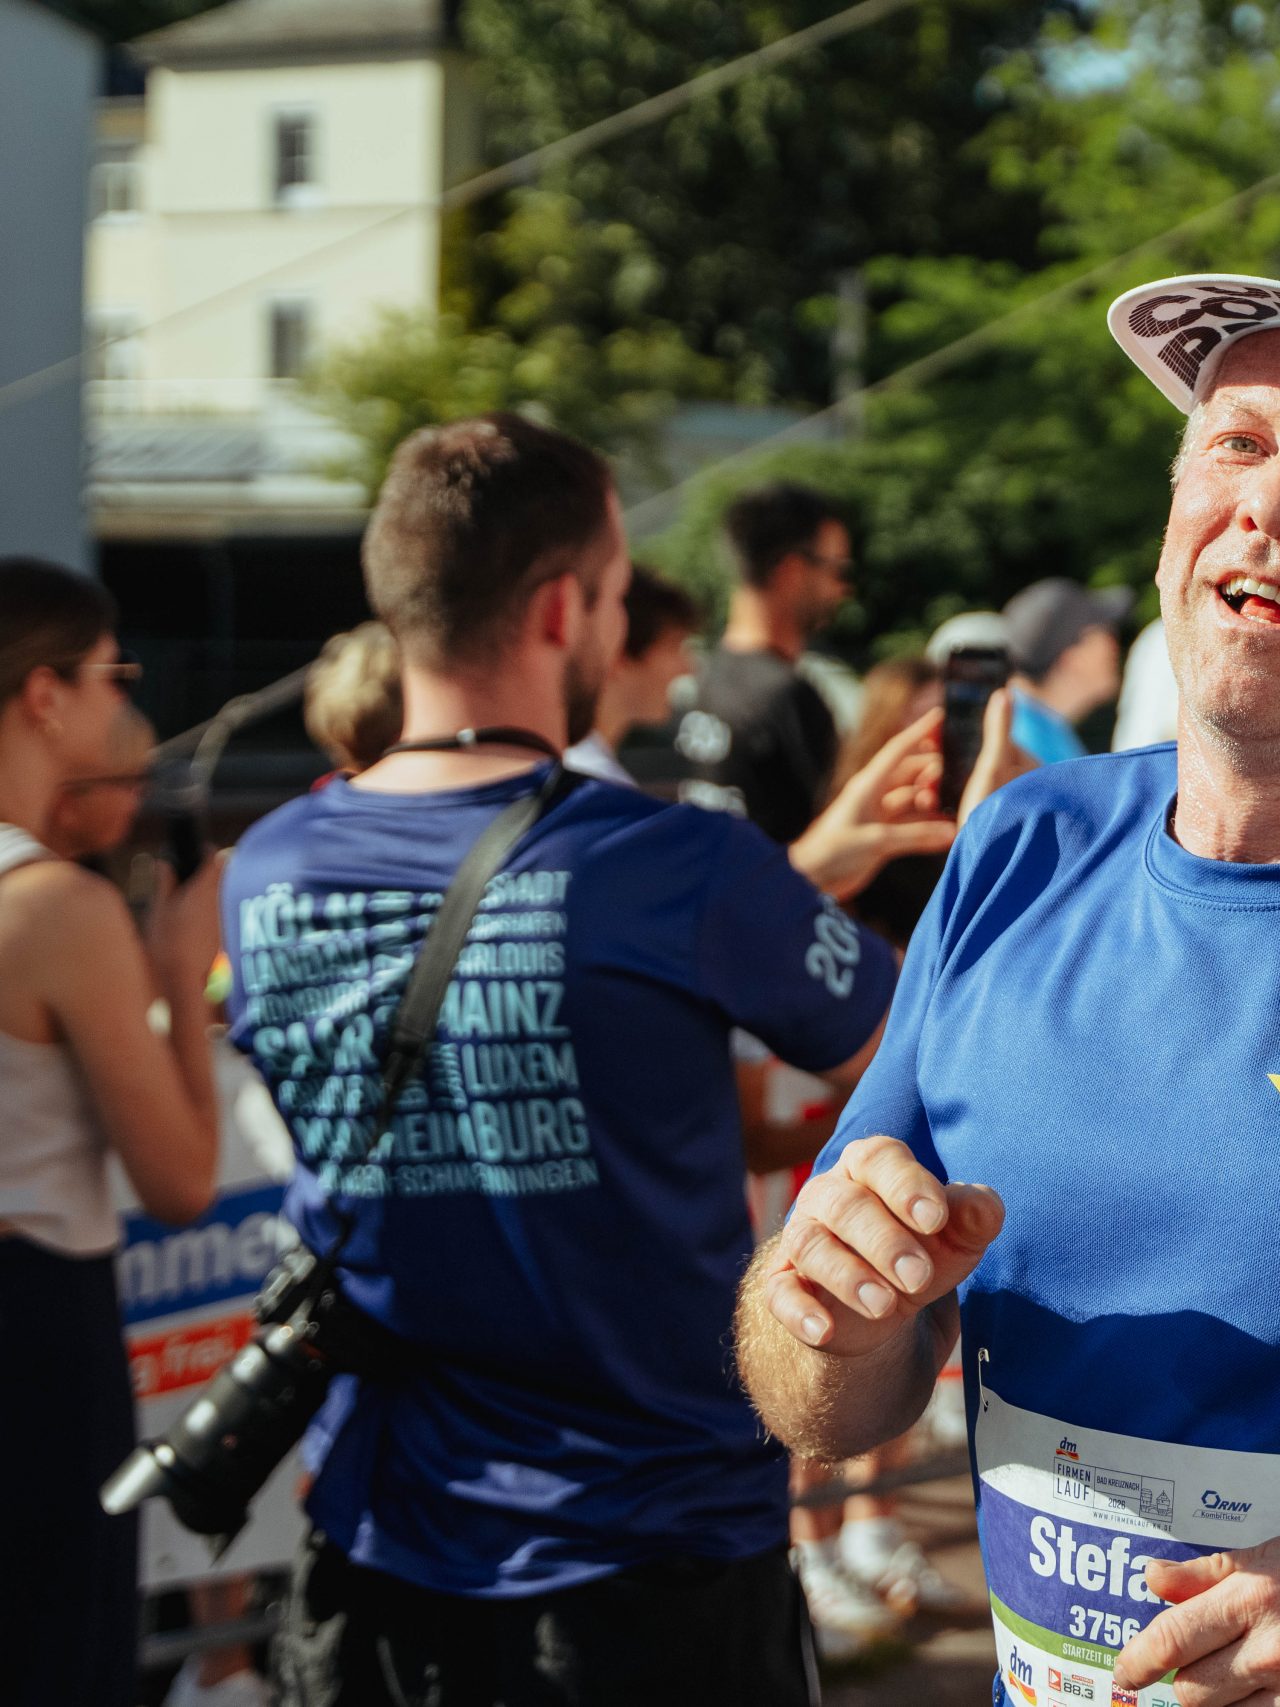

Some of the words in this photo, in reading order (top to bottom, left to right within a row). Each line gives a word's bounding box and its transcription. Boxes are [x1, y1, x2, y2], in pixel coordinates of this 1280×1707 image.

[470, 1097, 591, 1162] BURG
[1060, 1437, 1077, 1452] dm
[1057, 1464, 1091, 1482] FIRMEN
[1096, 1476, 1108, 1485] BAD
[1057, 1478, 1090, 1501] LAUF
[1029, 1515, 1176, 1606] Stefa
[1069, 1605, 1141, 1646] 3756
[1010, 1645, 1033, 1686] dm
[1062, 1642, 1101, 1663] STARTZEIT
[1103, 1652, 1117, 1667] 18:
[1063, 1682, 1095, 1700] 88.3
